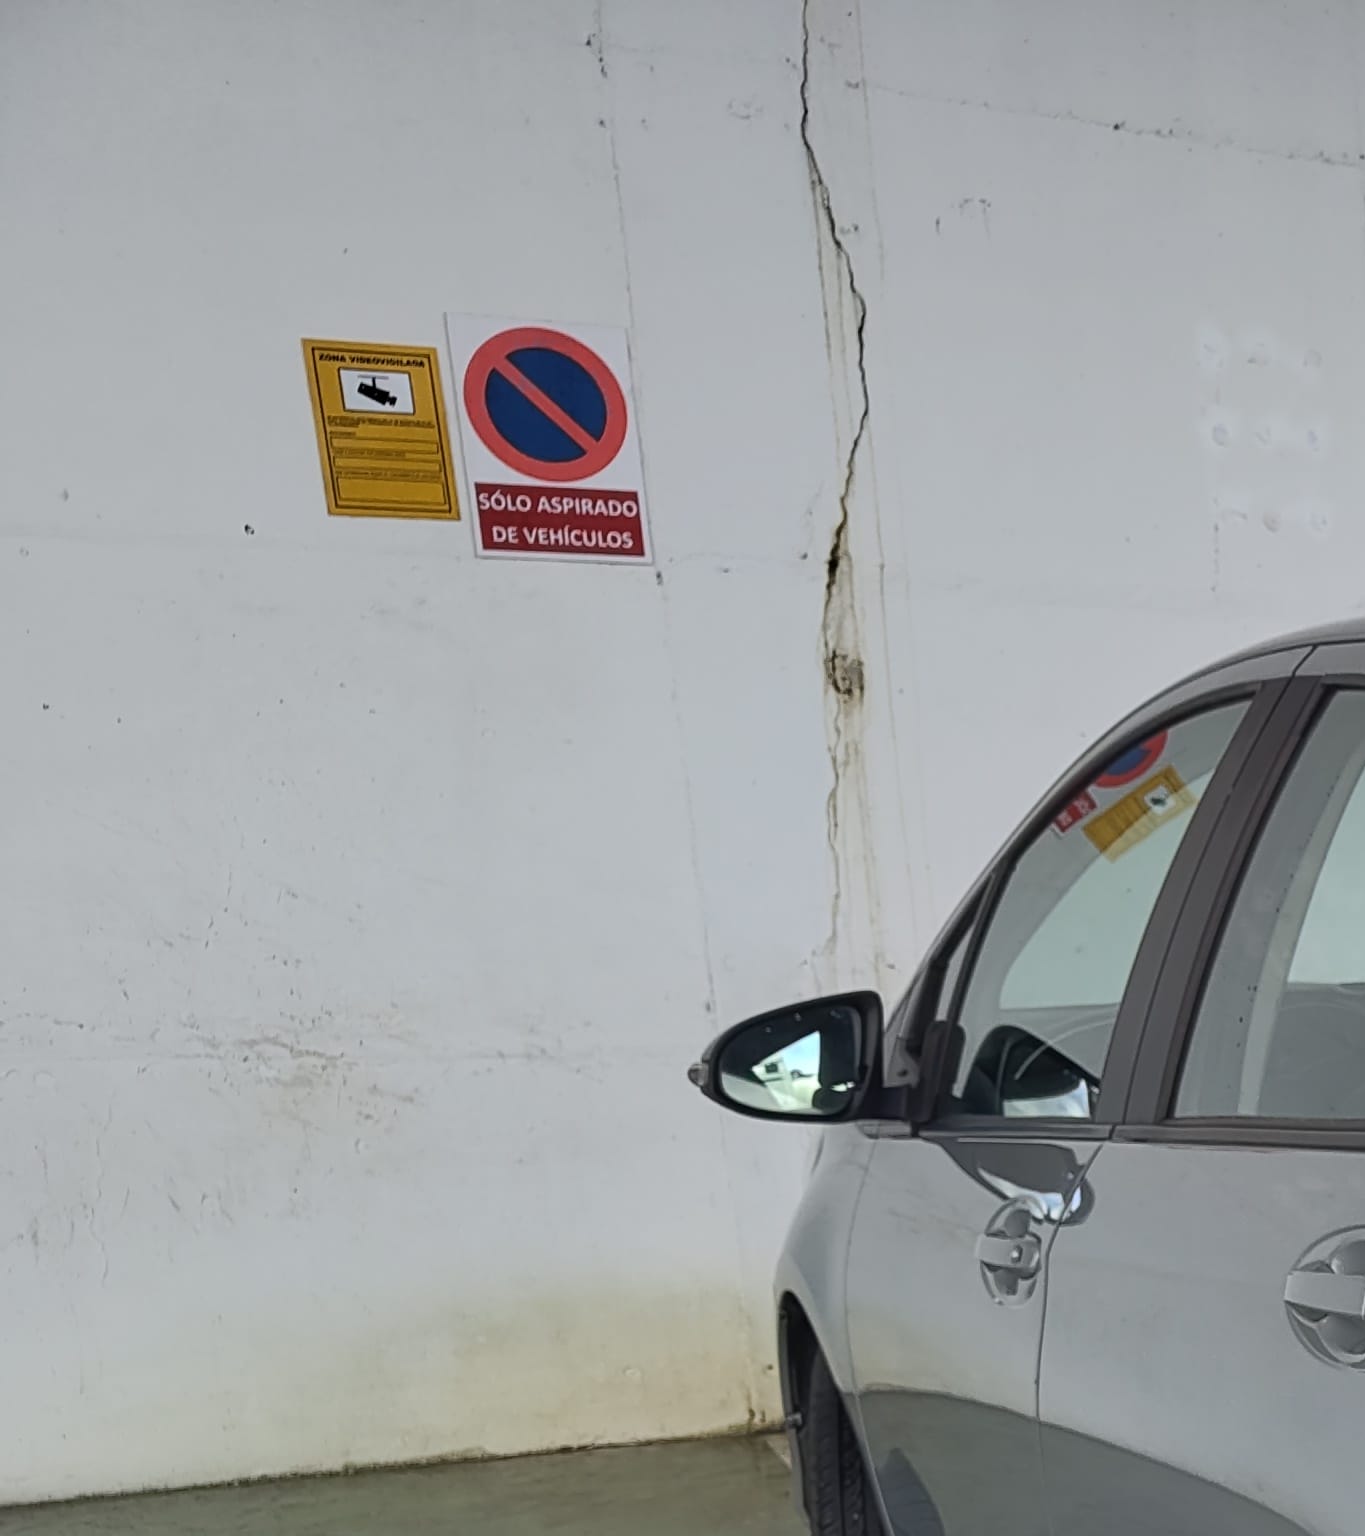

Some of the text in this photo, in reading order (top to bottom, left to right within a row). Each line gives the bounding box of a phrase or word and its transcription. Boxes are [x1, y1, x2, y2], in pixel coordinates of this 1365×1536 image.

[478, 489, 638, 517] SÓLO ASPIRADO
[492, 525, 634, 548] DE VEHÍCULOS
